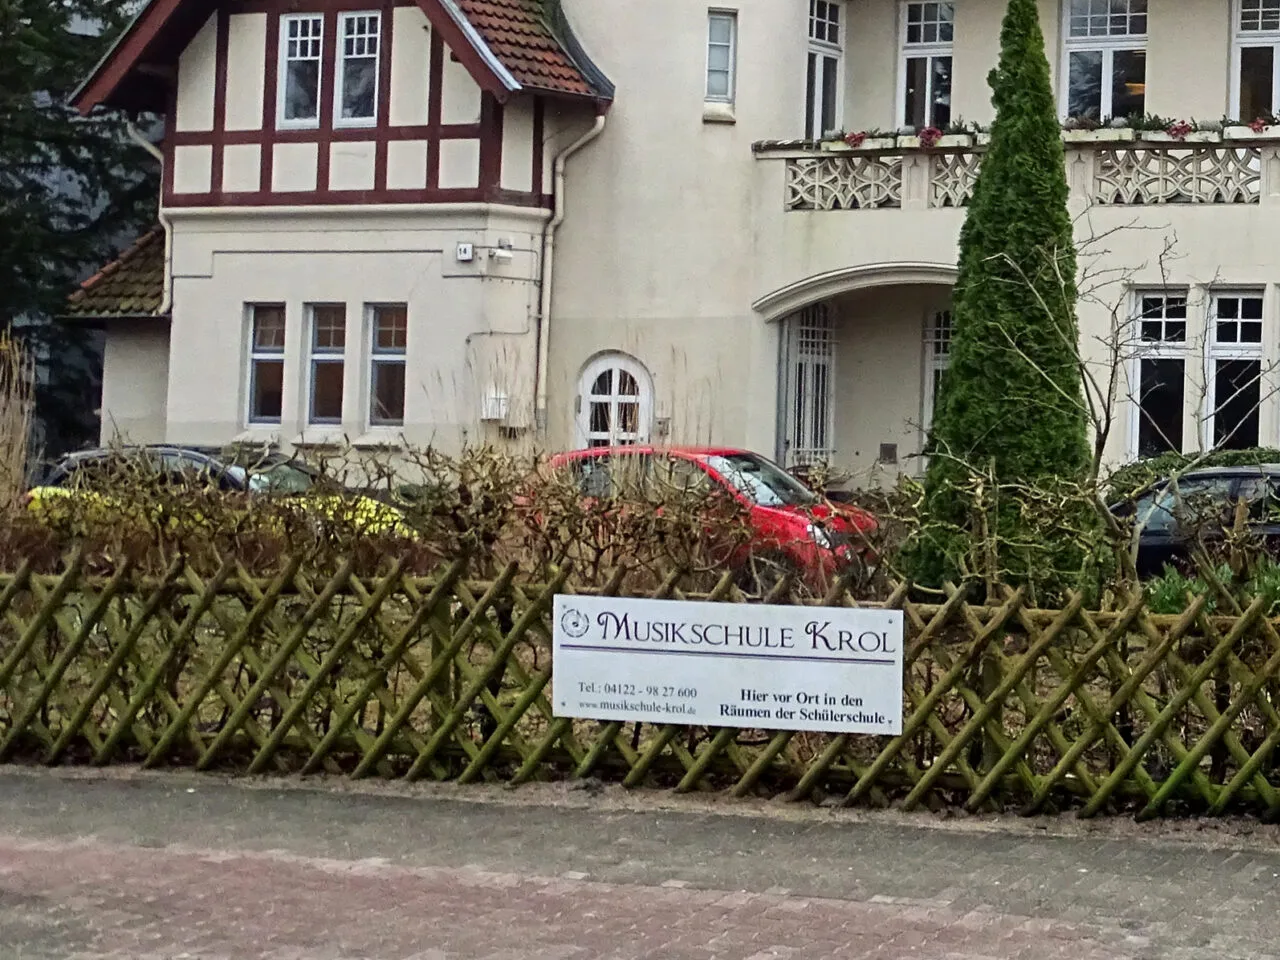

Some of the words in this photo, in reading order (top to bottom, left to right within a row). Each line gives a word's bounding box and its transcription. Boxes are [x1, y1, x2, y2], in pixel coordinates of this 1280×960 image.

[597, 611, 795, 649] MUSIKSCHULE
[804, 620, 896, 653] KROL
[604, 683, 635, 696] 04122
[646, 685, 658, 696] 98
[662, 686, 675, 697] 27
[677, 687, 697, 699] 600
[740, 688, 769, 702] Hier
[772, 693, 792, 704] vor
[796, 692, 819, 705] Ort
[823, 692, 836, 706] in
[840, 694, 863, 707] den
[719, 704, 771, 719] Räumen
[775, 707, 796, 720] der
[799, 708, 885, 725] Schülerschule
